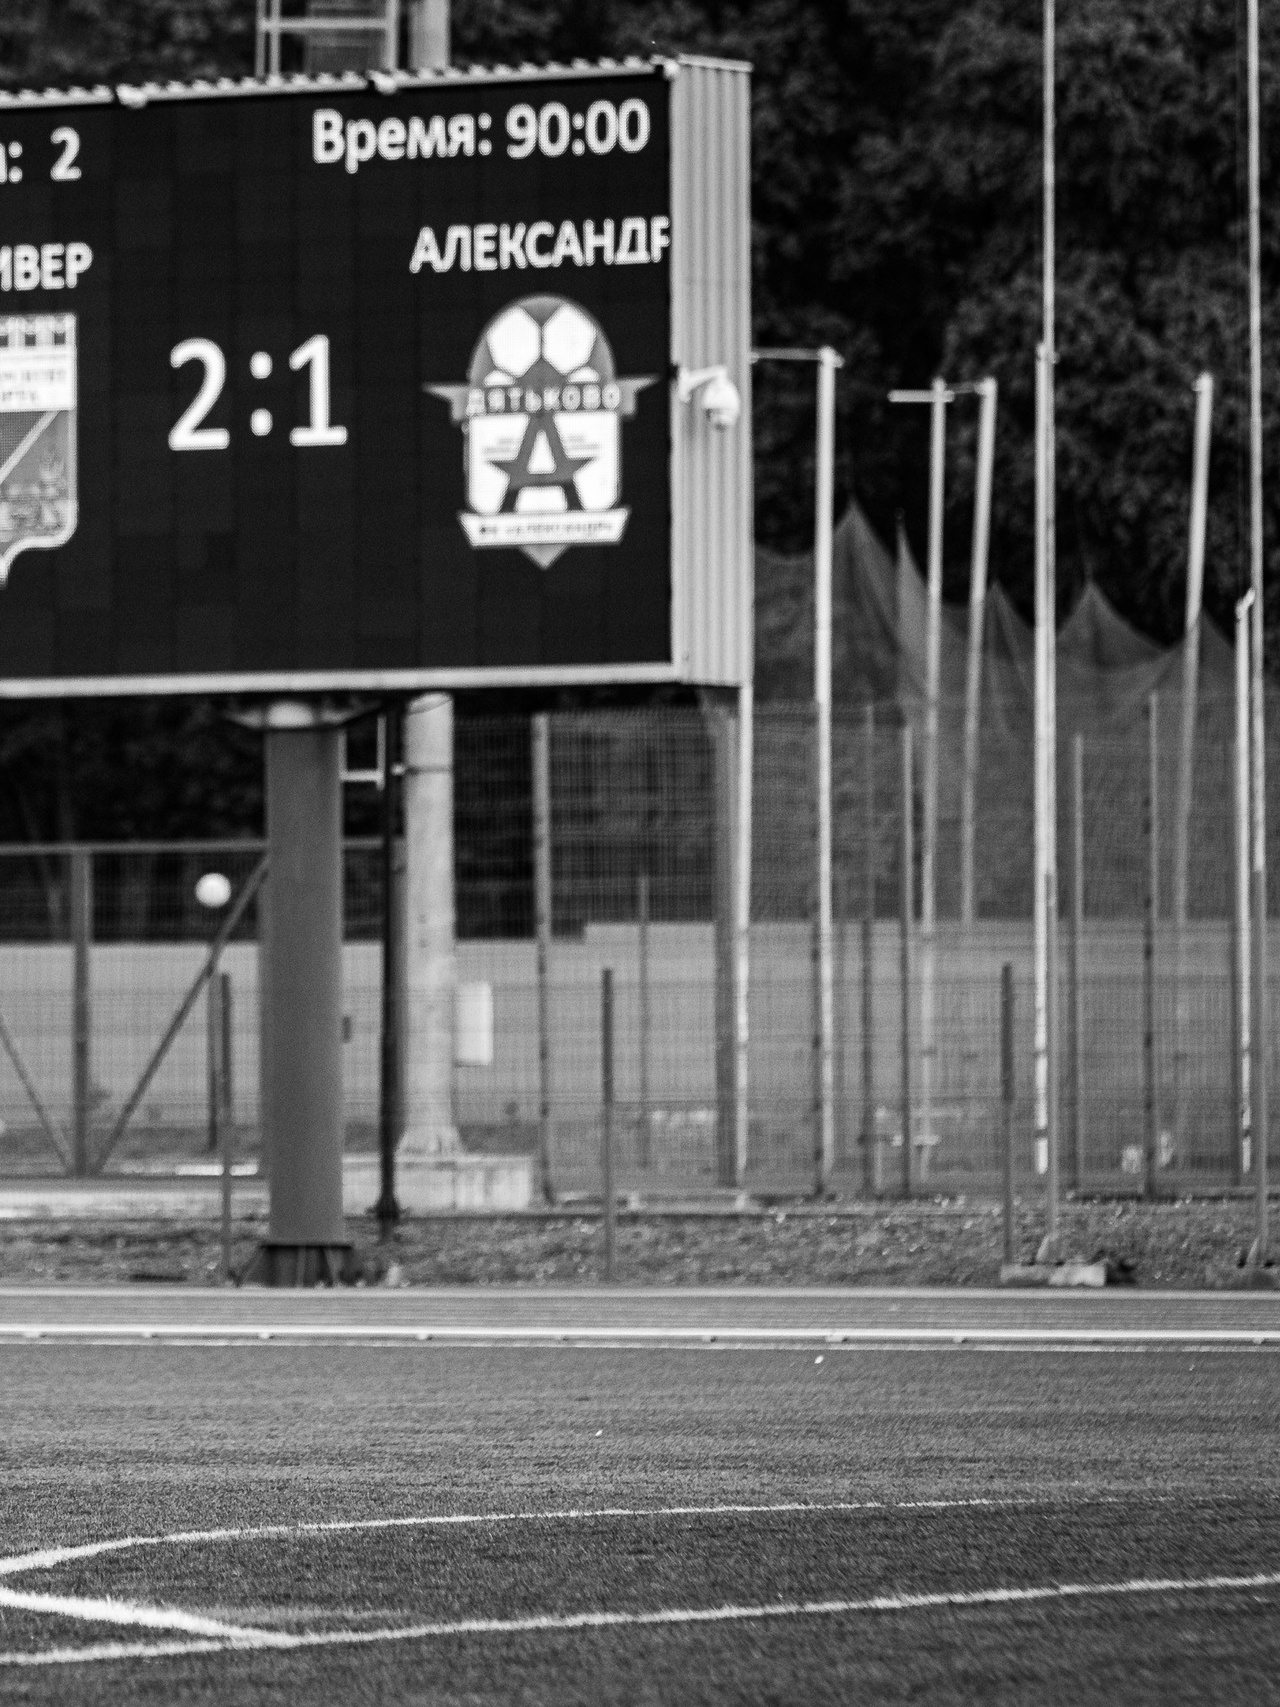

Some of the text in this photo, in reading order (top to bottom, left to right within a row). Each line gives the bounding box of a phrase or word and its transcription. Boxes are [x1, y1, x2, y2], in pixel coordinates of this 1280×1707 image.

[51, 127, 81, 180] 2
[313, 99, 650, 174] Время: 90:00
[168, 335, 347, 451] 2:1
